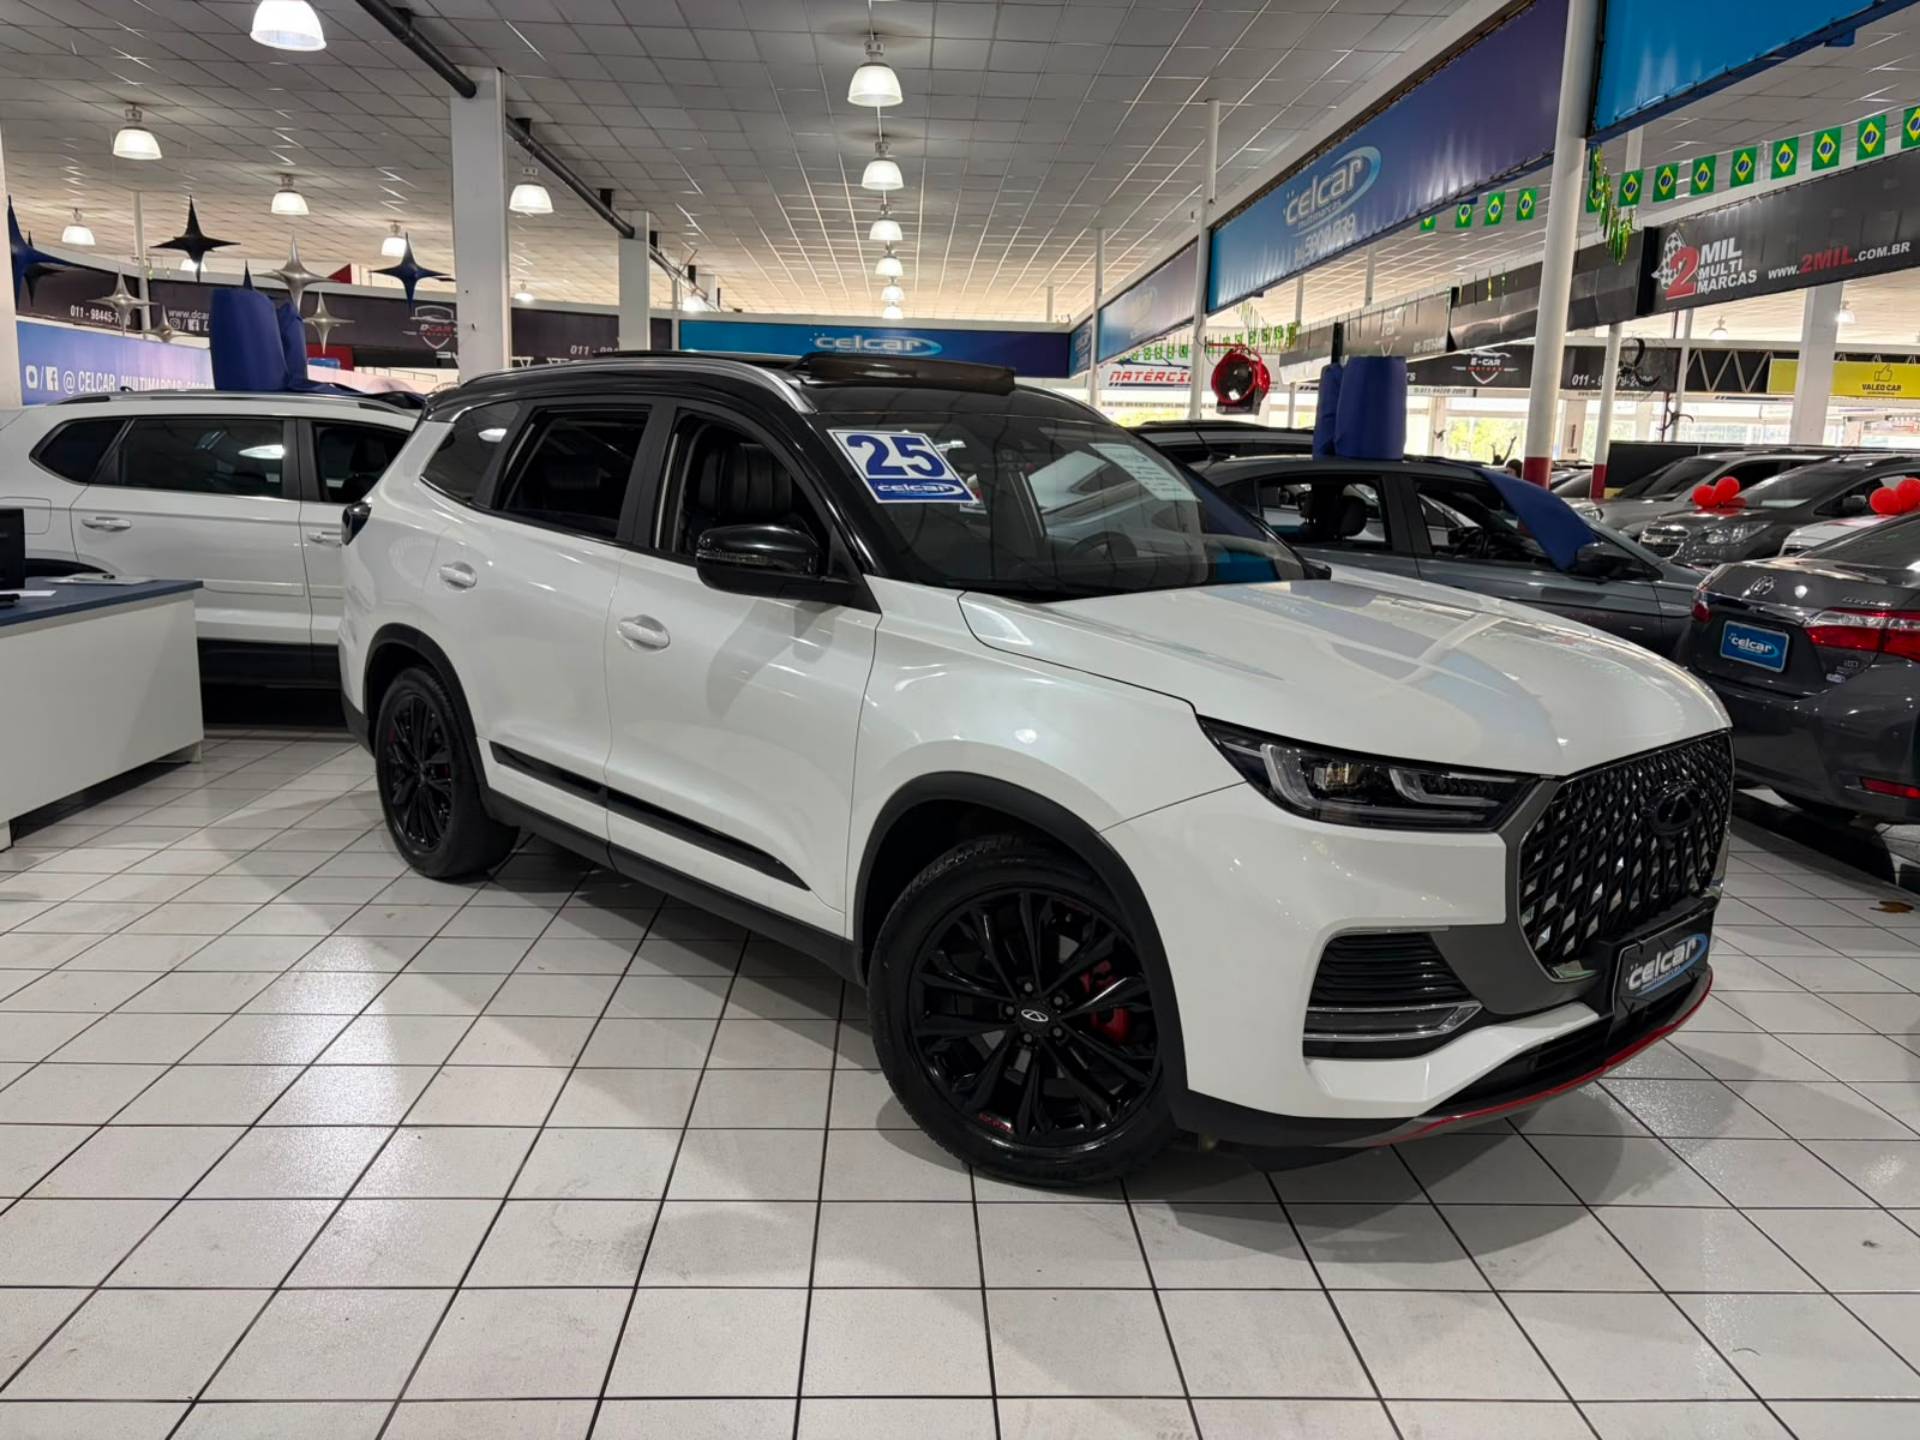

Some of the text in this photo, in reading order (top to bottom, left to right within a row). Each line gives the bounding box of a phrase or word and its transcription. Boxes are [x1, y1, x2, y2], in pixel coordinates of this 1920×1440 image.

[1285, 158, 1362, 225] celcar
[1701, 237, 1742, 265] MIL
[1664, 246, 1700, 300] 2
[1698, 259, 1743, 279] MULTI
[1697, 269, 1758, 294] MARCAS
[70, 305, 84, 318] 011
[570, 345, 588, 354] 011
[816, 335, 921, 351] celcar
[1470, 357, 1501, 366] E-CAR
[78, 371, 115, 392] CELCAR
[1571, 374, 1589, 387] 011
[846, 434, 945, 477] 25
[877, 483, 950, 492] celcar
[1731, 637, 1772, 653] celcar
[1628, 937, 1697, 990] celcar
